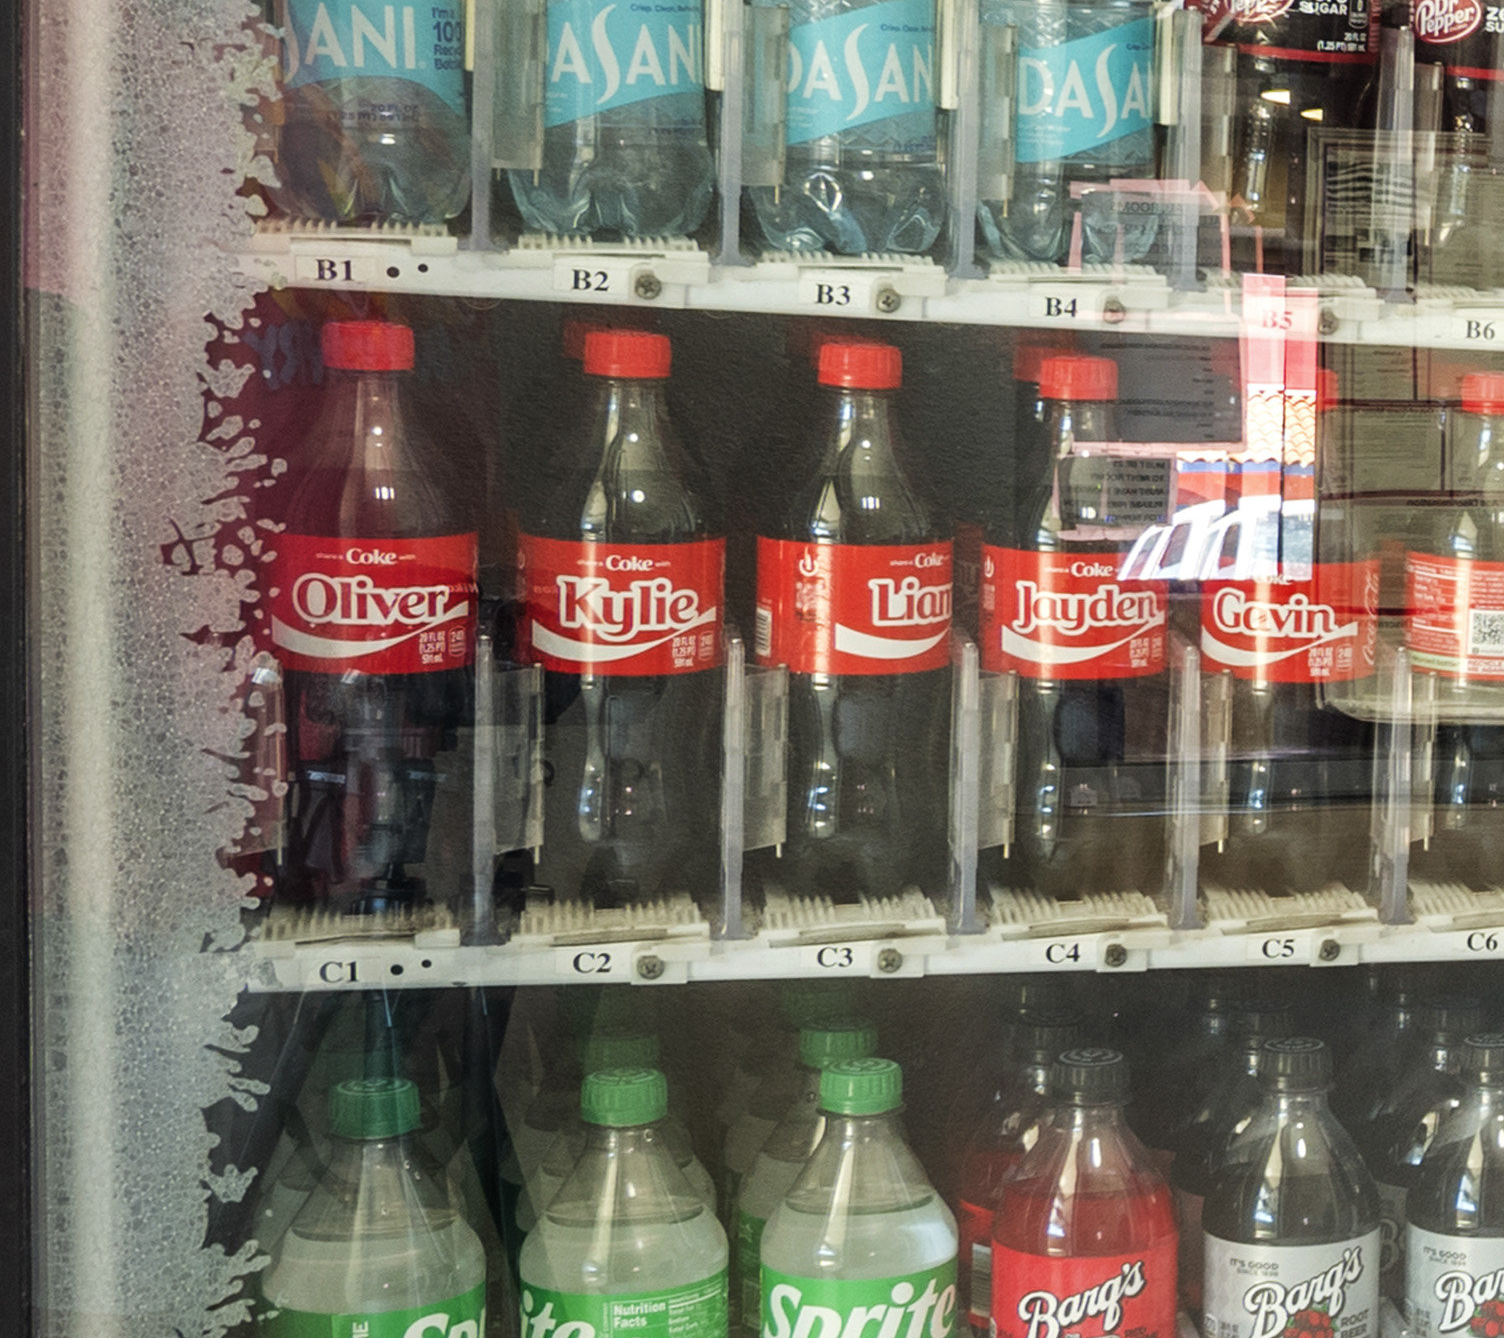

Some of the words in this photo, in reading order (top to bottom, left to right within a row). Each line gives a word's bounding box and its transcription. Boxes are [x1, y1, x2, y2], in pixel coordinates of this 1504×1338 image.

[1298, 0, 1349, 17] SUGAR
[316, 259, 353, 283] B1
[572, 269, 610, 292] B2
[815, 284, 852, 306] B3
[1044, 297, 1078, 318] B4
[1464, 320, 1496, 341] B6
[345, 546, 397, 566] Coke
[293, 572, 450, 627] Oliver
[556, 573, 699, 641] Kylie
[1011, 580, 1163, 635] Jayden
[1213, 586, 1336, 639] Gavin
[816, 946, 853, 967] C3
[1261, 938, 1295, 959] C5
[319, 961, 359, 983] C1
[573, 952, 611, 974] C2
[1340, 1309, 1371, 1328] ROOT
